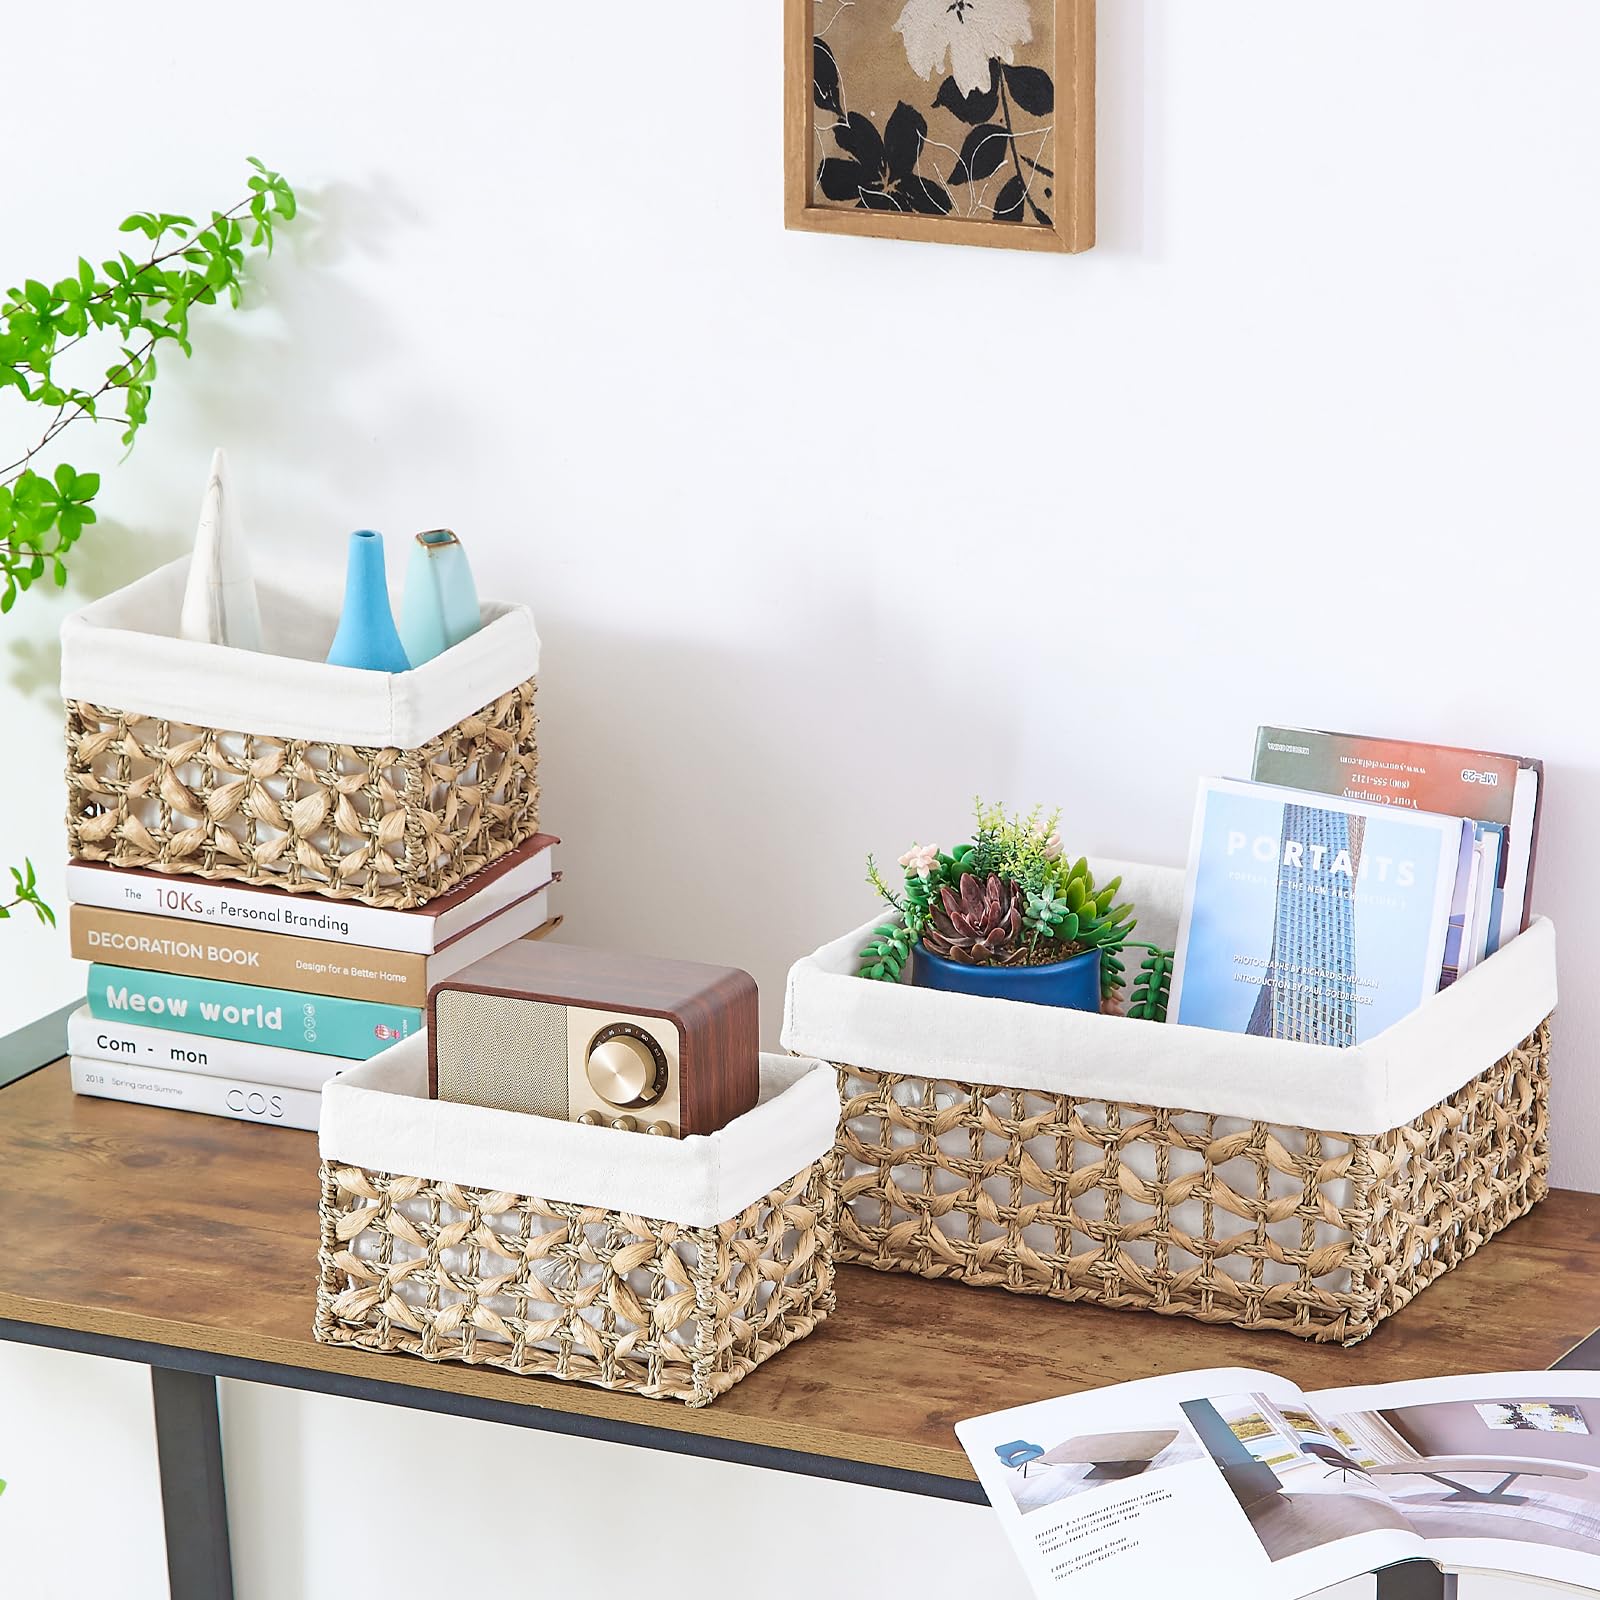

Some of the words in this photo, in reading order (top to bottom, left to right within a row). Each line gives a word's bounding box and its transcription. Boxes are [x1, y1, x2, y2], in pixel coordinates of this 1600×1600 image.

[1351, 774, 1388, 786] 555-1212
[1389, 778, 1410, 788] (800)
[1461, 769, 1498, 785] MF-29
[1341, 787, 1390, 805] Company
[1392, 797, 1419, 809] Your
[1287, 881, 1304, 891] THE
[1307, 886, 1329, 895] NEW
[125, 888, 142, 899] The
[156, 888, 203, 914] 10Ks
[206, 907, 215, 916] of
[220, 901, 280, 922] Personal
[284, 910, 349, 935] Branding
[87, 930, 203, 959] DECORATION
[207, 946, 260, 967] BOOK
[295, 959, 327, 973] Design
[328, 964, 341, 974] for
[343, 968, 349, 976] a
[351, 967, 378, 979] Better
[379, 972, 407, 983] Home
[1302, 966, 1336, 980] RICHARD
[1233, 973, 1290, 990] INTRODUCTION
[1303, 984, 1323, 997] PAUL
[106, 985, 188, 1017] Meow
[200, 1001, 282, 1031] world
[96, 1035, 136, 1054] Com
[170, 1048, 208, 1065] mon
[85, 1074, 104, 1084] 2018
[111, 1077, 136, 1090] Spring
[137, 1081, 152, 1091] and
[225, 1089, 284, 1118] COS
